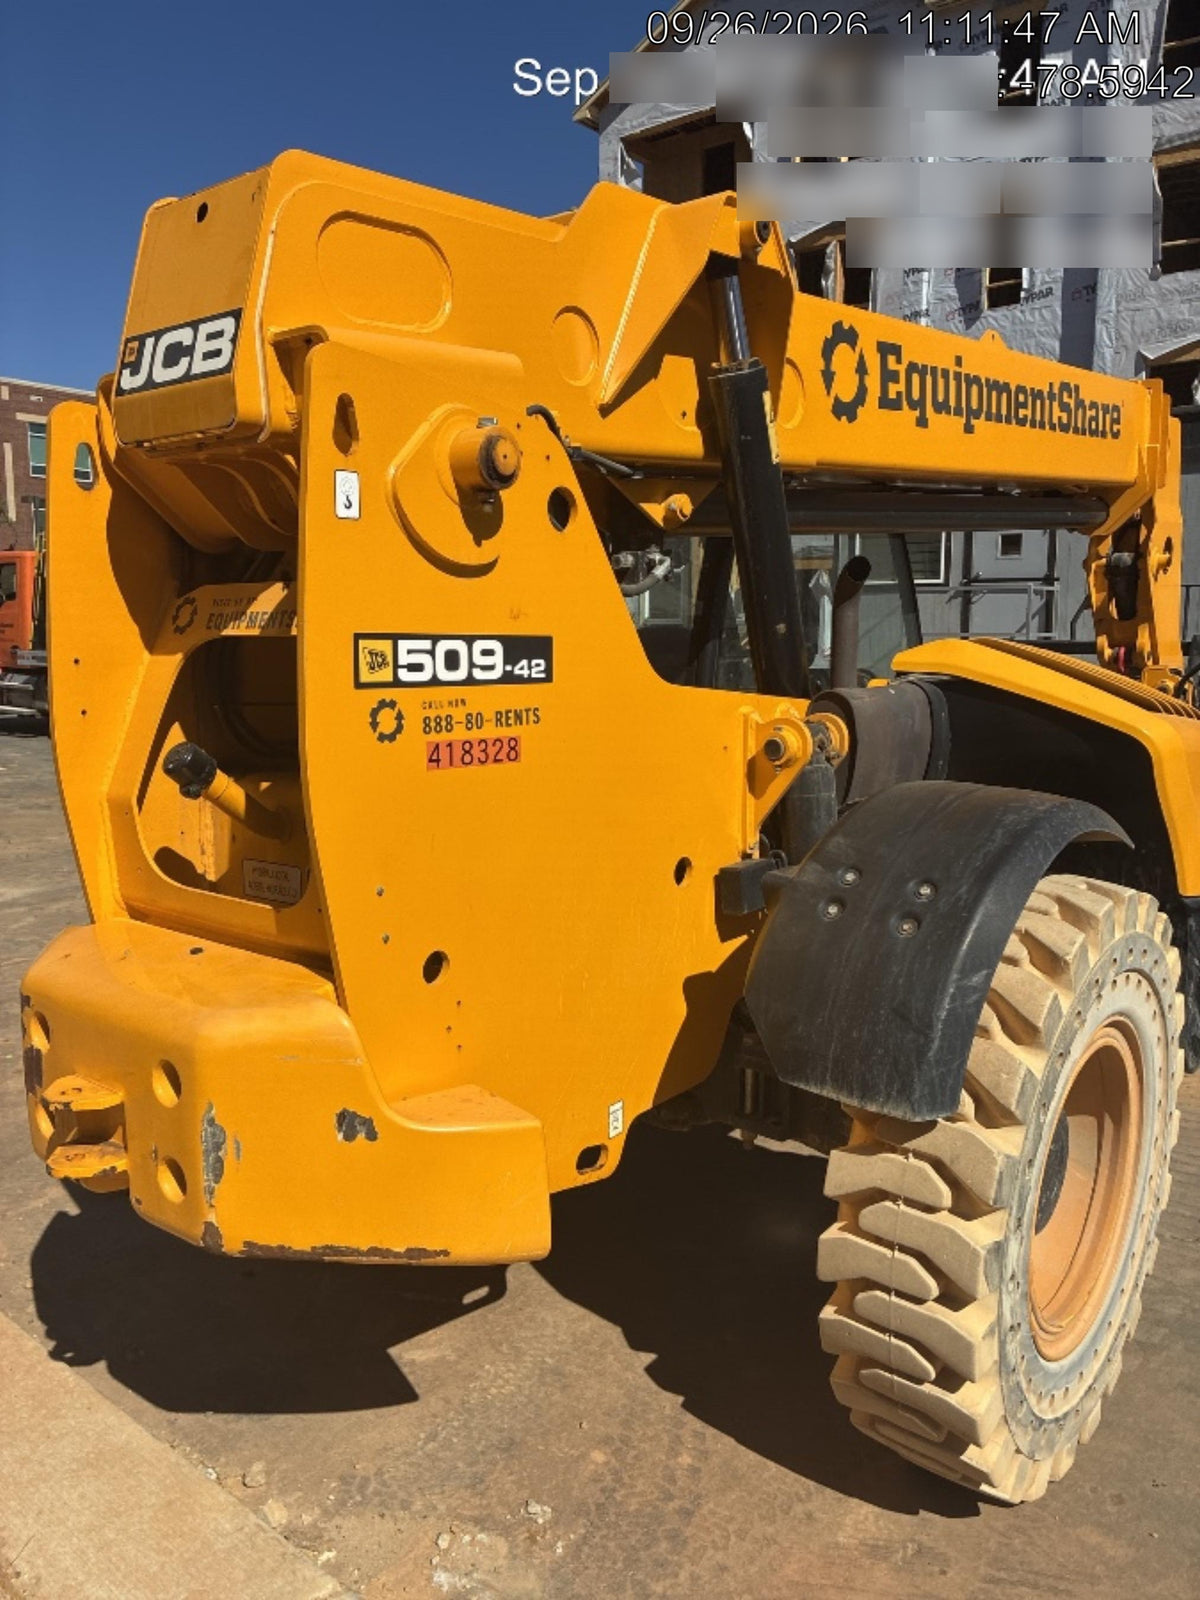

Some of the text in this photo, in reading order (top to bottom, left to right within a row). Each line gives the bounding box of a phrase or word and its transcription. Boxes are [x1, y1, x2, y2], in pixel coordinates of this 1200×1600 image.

[120, 316, 236, 390] JCB
[876, 340, 1121, 440] EquipmentShare
[397, 638, 547, 682] 509-42
[422, 707, 541, 735] 888-80-RENTS
[428, 737, 519, 769] 418328
